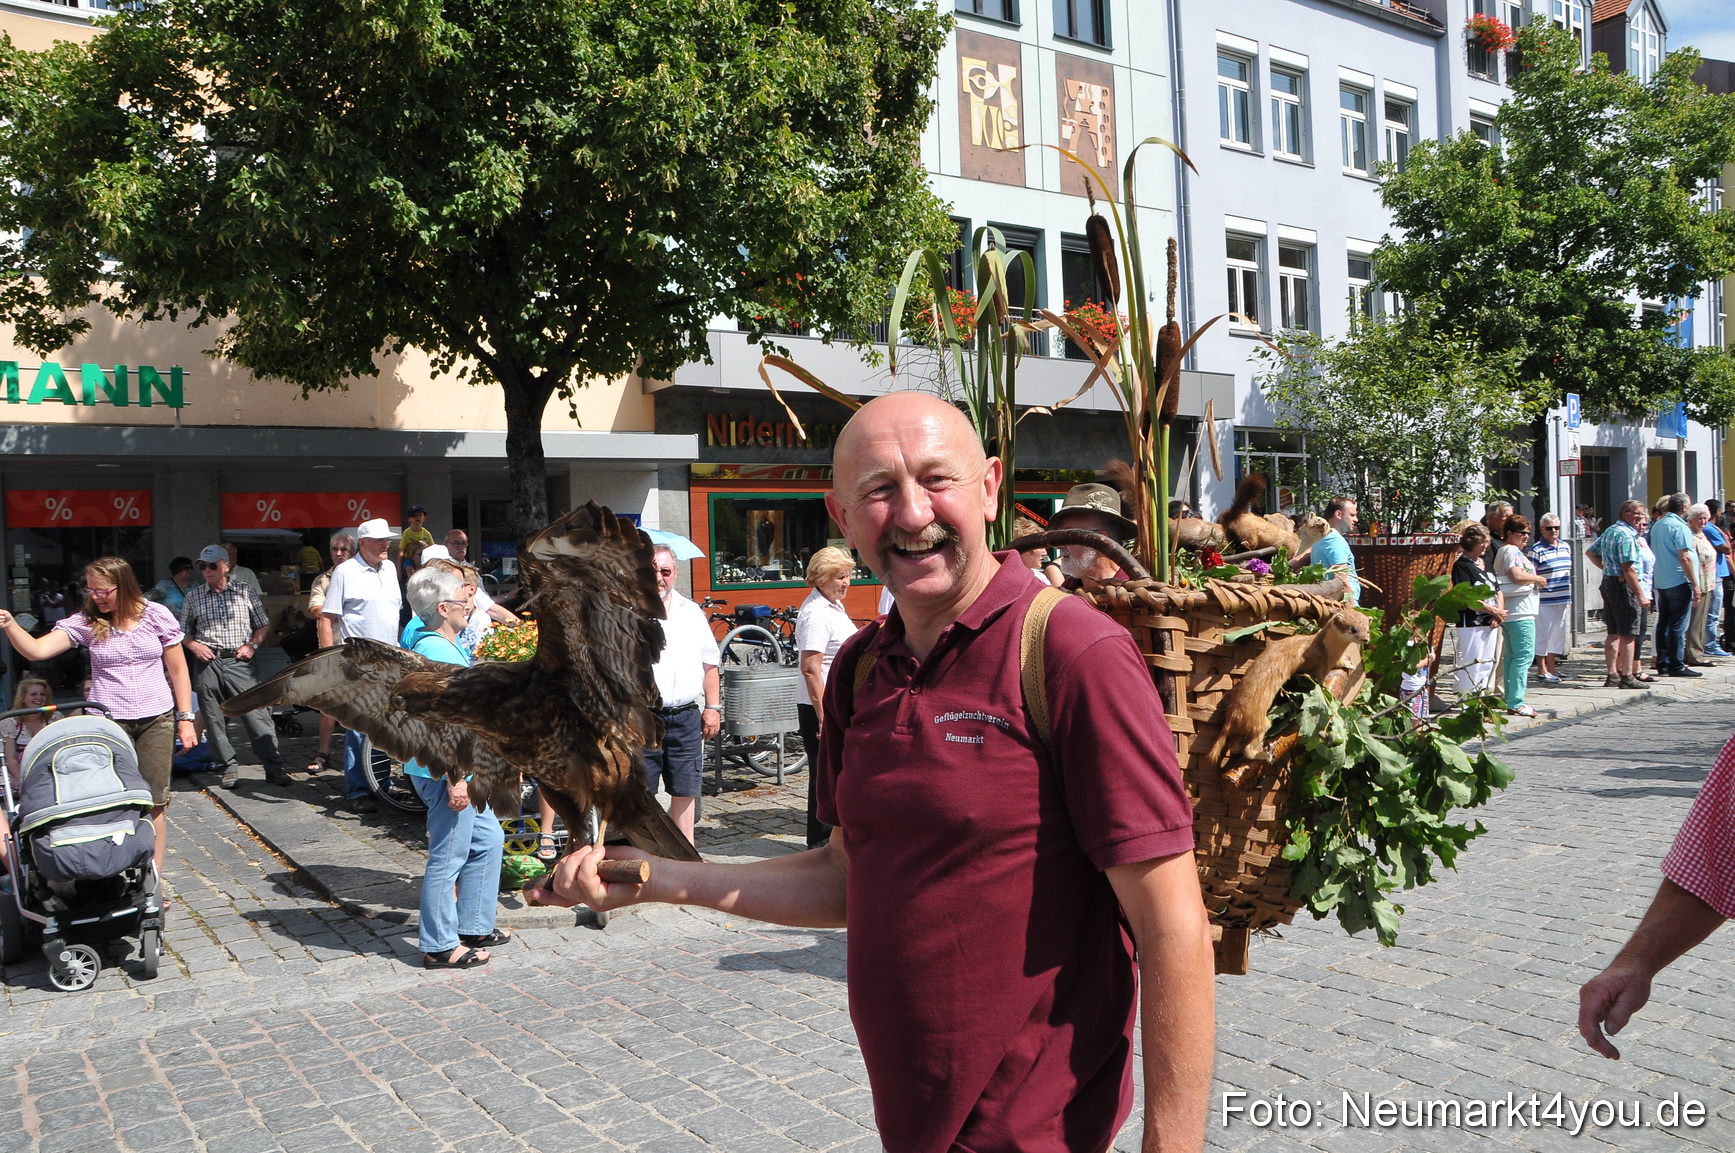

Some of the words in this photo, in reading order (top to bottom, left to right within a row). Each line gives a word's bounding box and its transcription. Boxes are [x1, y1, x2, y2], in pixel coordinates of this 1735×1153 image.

[1570, 398, 1578, 424] P
[44, 496, 73, 521] %
[113, 496, 140, 520] %
[256, 499, 281, 523] %
[347, 498, 371, 521] %
[933, 710, 1010, 730] Geflügelzuchtverein
[945, 732, 984, 744] Neumarkt
